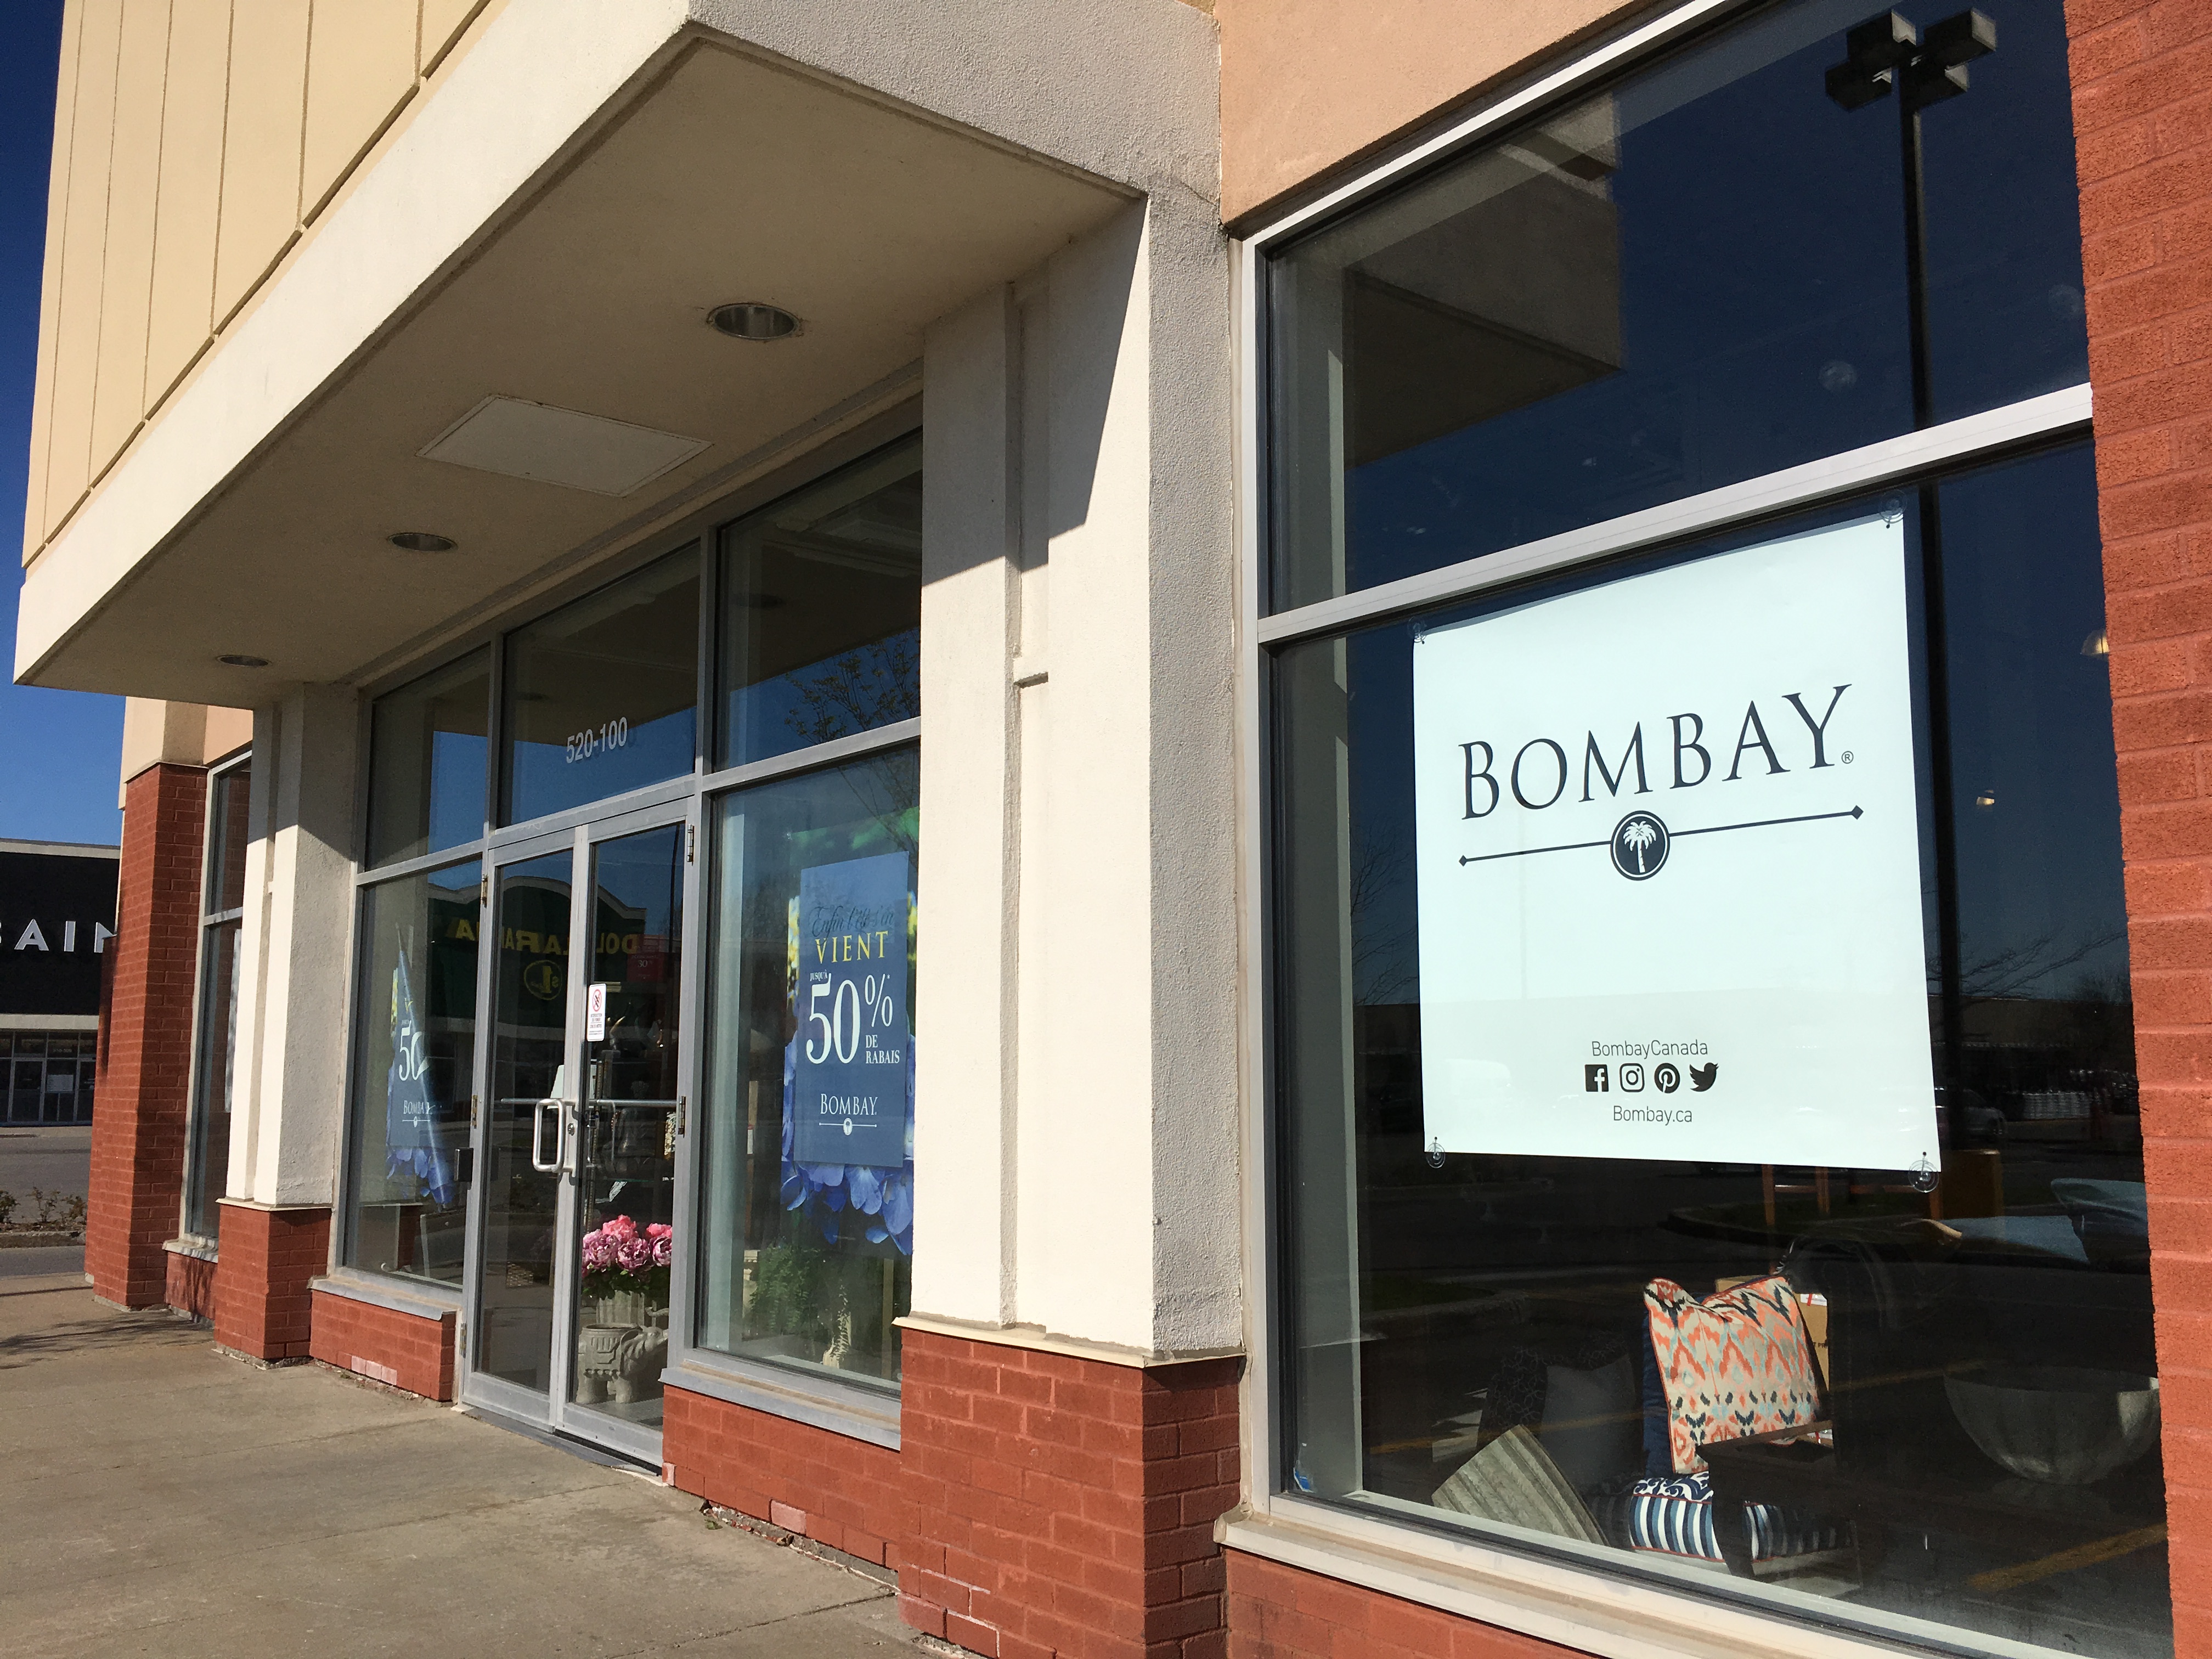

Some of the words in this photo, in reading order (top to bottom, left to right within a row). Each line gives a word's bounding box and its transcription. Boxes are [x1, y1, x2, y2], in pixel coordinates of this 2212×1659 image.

[566, 716, 628, 764] 520-100
[815, 930, 888, 964] VIENT
[865, 1034, 878, 1048] DE
[1592, 1039, 1708, 1060] BombayCanada
[865, 1049, 900, 1065] RABAIS
[820, 1093, 878, 1115] BOMBAY
[1613, 1105, 1692, 1126] Bombay.ca
